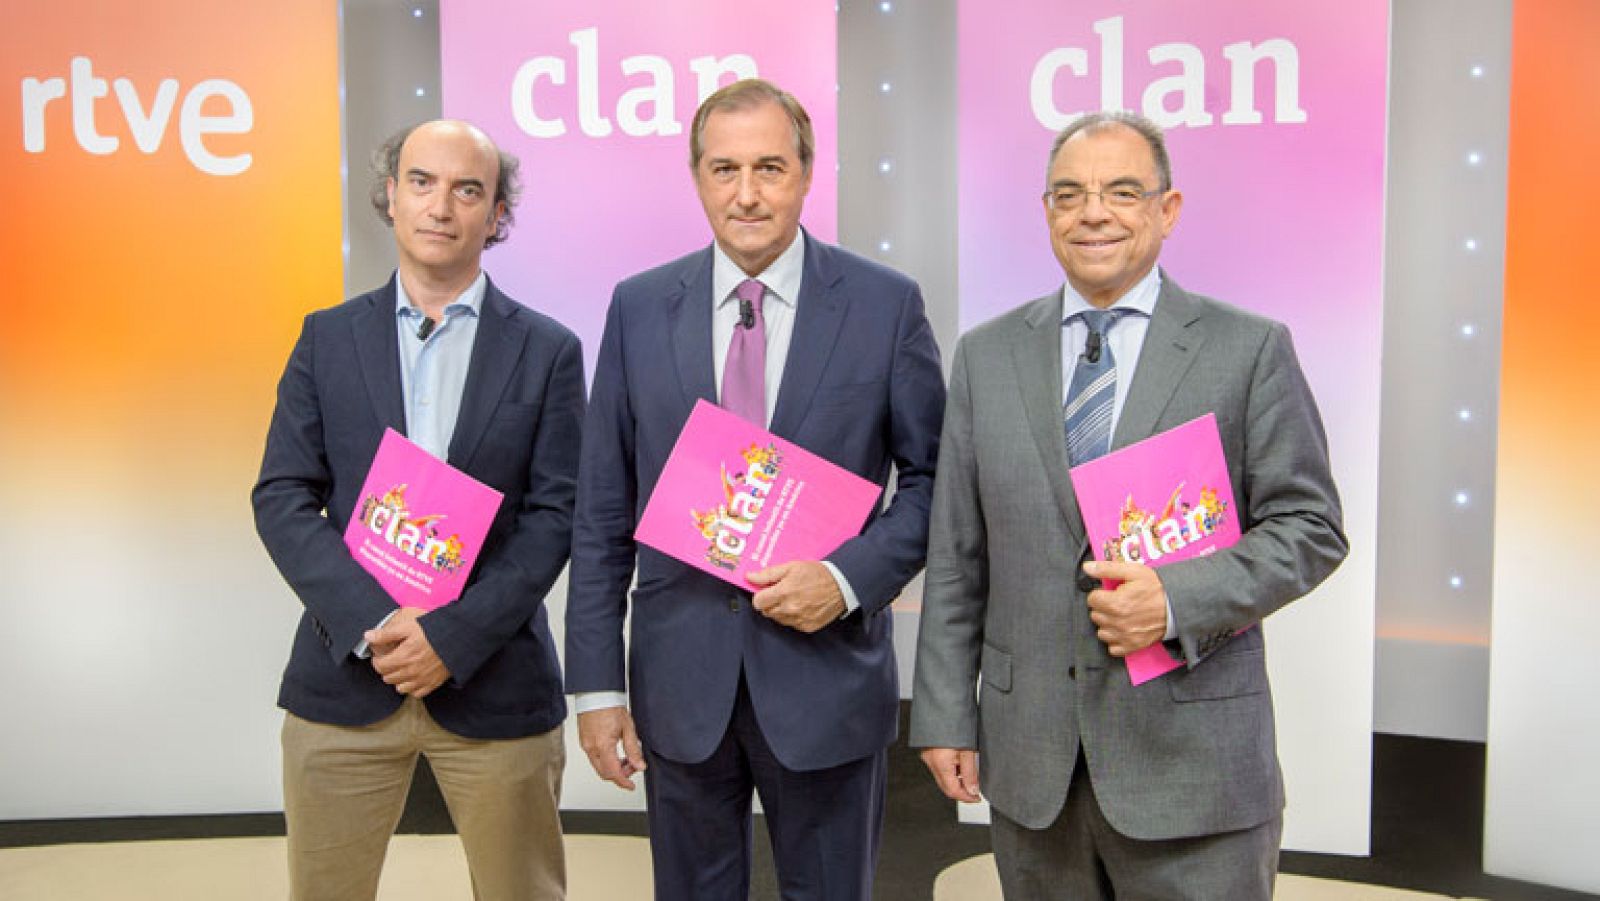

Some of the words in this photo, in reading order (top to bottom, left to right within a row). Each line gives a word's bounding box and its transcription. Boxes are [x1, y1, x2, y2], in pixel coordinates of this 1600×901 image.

[22, 57, 254, 176] rtve
[1030, 16, 1307, 132] clan
[370, 506, 446, 566] clan
[714, 462, 778, 556] clan
[1120, 505, 1212, 565] clan
